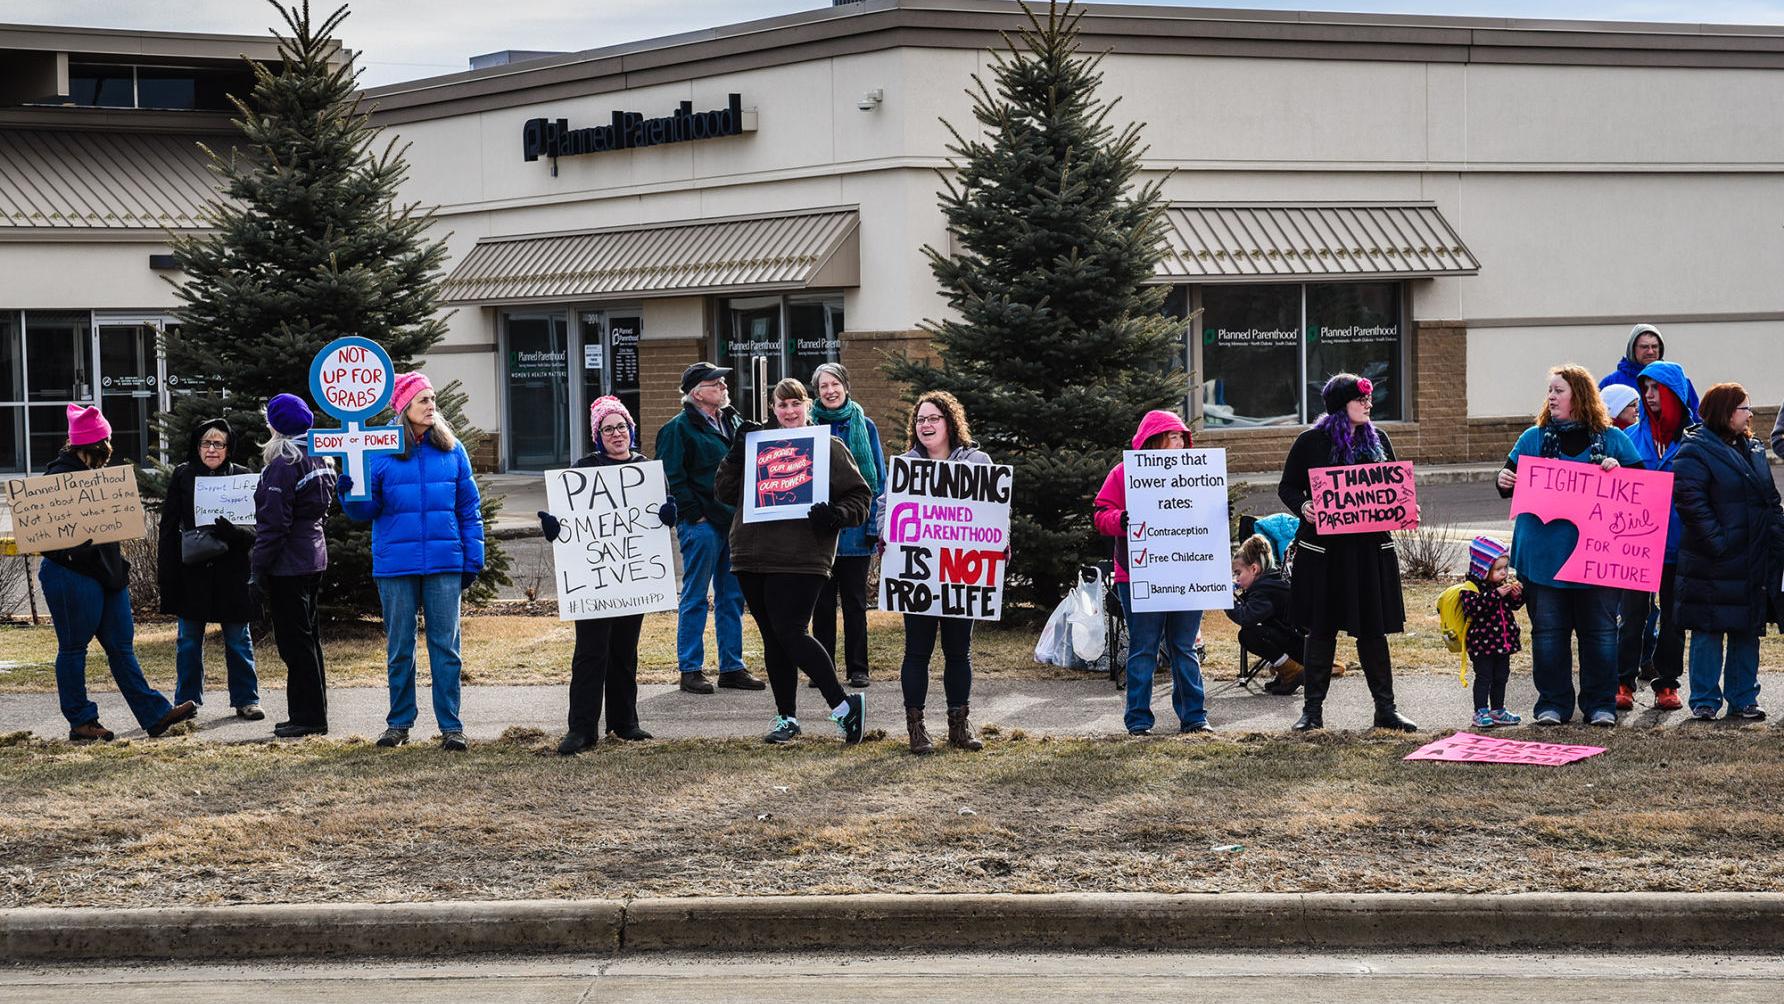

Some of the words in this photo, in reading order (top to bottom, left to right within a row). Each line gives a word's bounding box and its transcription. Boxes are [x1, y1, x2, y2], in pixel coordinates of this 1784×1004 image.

[546, 111, 624, 157] Planned
[622, 93, 743, 148] Parenthood
[1218, 328, 1250, 339] Planned
[1252, 328, 1298, 339] Parenthood
[1320, 326, 1352, 337] Planned
[1353, 324, 1398, 336] Parenthood
[728, 340, 750, 351] Planned
[750, 339, 781, 350] Parenthood
[797, 338, 821, 349] Planned
[338, 346, 368, 363] NOT
[518, 350, 537, 361] Planned
[538, 350, 565, 361] Parenthood
[323, 369, 347, 384] UP
[351, 369, 382, 384] FOR
[326, 386, 376, 408] GRABS
[314, 436, 344, 449] BODY
[364, 434, 398, 446] POWER
[758, 454, 773, 465] OUR
[773, 447, 795, 460] BODIES
[769, 464, 785, 473] OUR
[786, 459, 807, 472] MINDS
[1134, 453, 1178, 470] Things
[1181, 452, 1207, 466] that
[9, 477, 61, 500] Planned
[63, 468, 126, 490] Parenthood
[196, 481, 227, 492] Support
[232, 478, 257, 491] Life
[558, 465, 645, 511] PAP
[759, 480, 780, 491] OUR
[780, 473, 806, 489] POWER
[892, 457, 1012, 504] DEFUNDING
[1129, 475, 1167, 489] lower
[1171, 474, 1225, 488] abortion
[1325, 465, 1405, 490] THANKS
[1529, 465, 1594, 494] FIGHT
[1596, 476, 1645, 505] LIKE
[13, 501, 45, 514] Cares
[49, 496, 75, 507] about
[78, 488, 109, 505] ALL
[112, 490, 122, 500] of
[219, 494, 248, 503] Support
[1158, 498, 1193, 510] rates:
[1322, 488, 1397, 510] PLANNED
[18, 515, 41, 528] Not
[47, 510, 73, 524] just
[80, 507, 105, 517] what
[111, 505, 121, 514] I
[195, 505, 225, 515] Planned
[1317, 505, 1406, 529] PARENTHOOD
[1588, 503, 1603, 521] A
[1609, 508, 1654, 534] Girl
[26, 530, 52, 543] with
[58, 522, 78, 538] MY
[557, 502, 665, 544] SMEARS
[1147, 526, 1209, 538] Contraception
[586, 535, 644, 565] SAVE
[1149, 553, 1169, 563] Free
[1171, 551, 1214, 562] Childcare
[1585, 538, 1610, 553] FOR
[1622, 543, 1650, 560] OUR
[563, 554, 666, 595] LIVES
[898, 545, 933, 580] IS
[939, 547, 1006, 586] NOT
[1583, 560, 1650, 584] FUTURE
[884, 577, 997, 617] PRO-LIFE
[1150, 584, 1186, 595] Banning
[1188, 582, 1227, 593] Abortion
[568, 592, 665, 614] #ISTANDWITHPP
